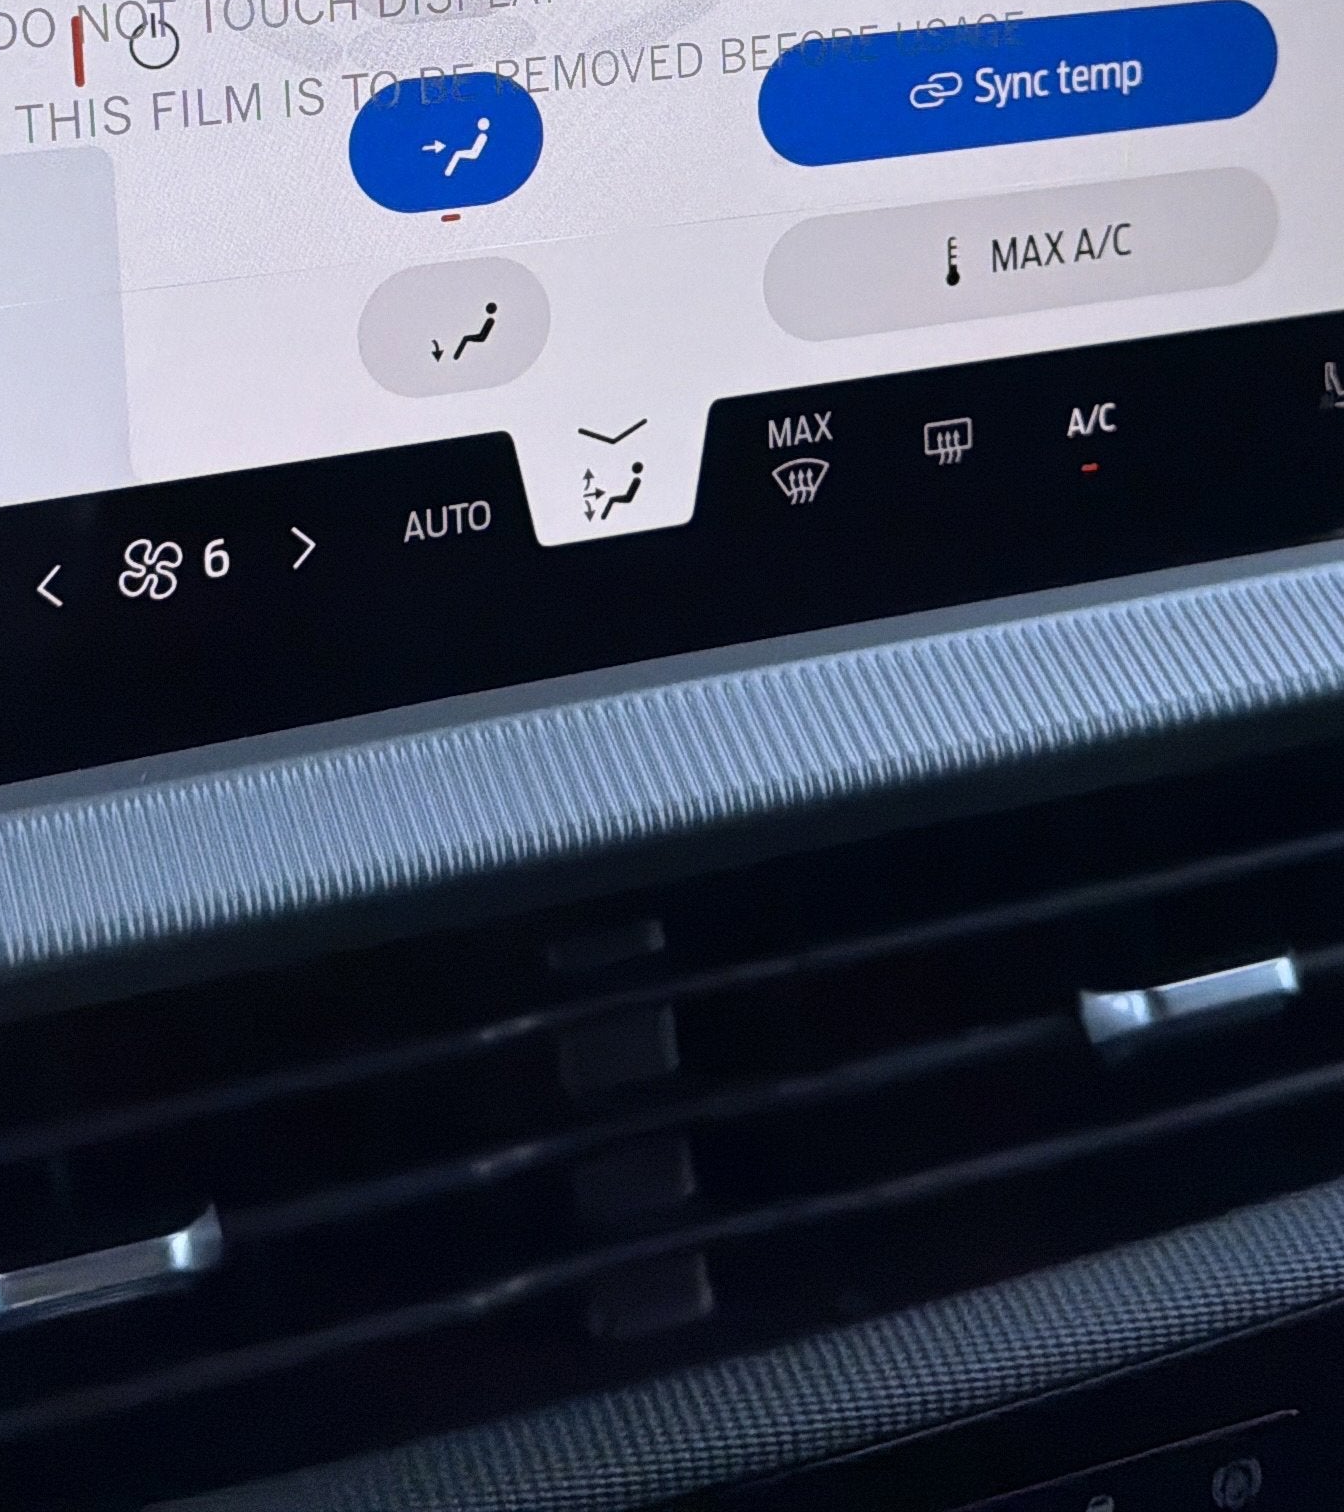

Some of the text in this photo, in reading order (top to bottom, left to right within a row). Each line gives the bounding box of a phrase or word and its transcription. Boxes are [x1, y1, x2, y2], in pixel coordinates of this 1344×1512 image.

[15, 95, 132, 144] THIS
[152, 84, 262, 131] FILM
[285, 77, 325, 119] IS
[341, 69, 401, 112] TO
[419, 62, 475, 106] BE
[495, 40, 704, 96] REMOVED
[721, 23, 879, 78] BEFORE
[973, 58, 1143, 115] Sync temp
[991, 223, 1132, 273] MAX A/C
[768, 411, 833, 449] MAX
[1067, 402, 1116, 437] A/C
[403, 500, 492, 543] AUTO
[203, 538, 230, 578] 6
